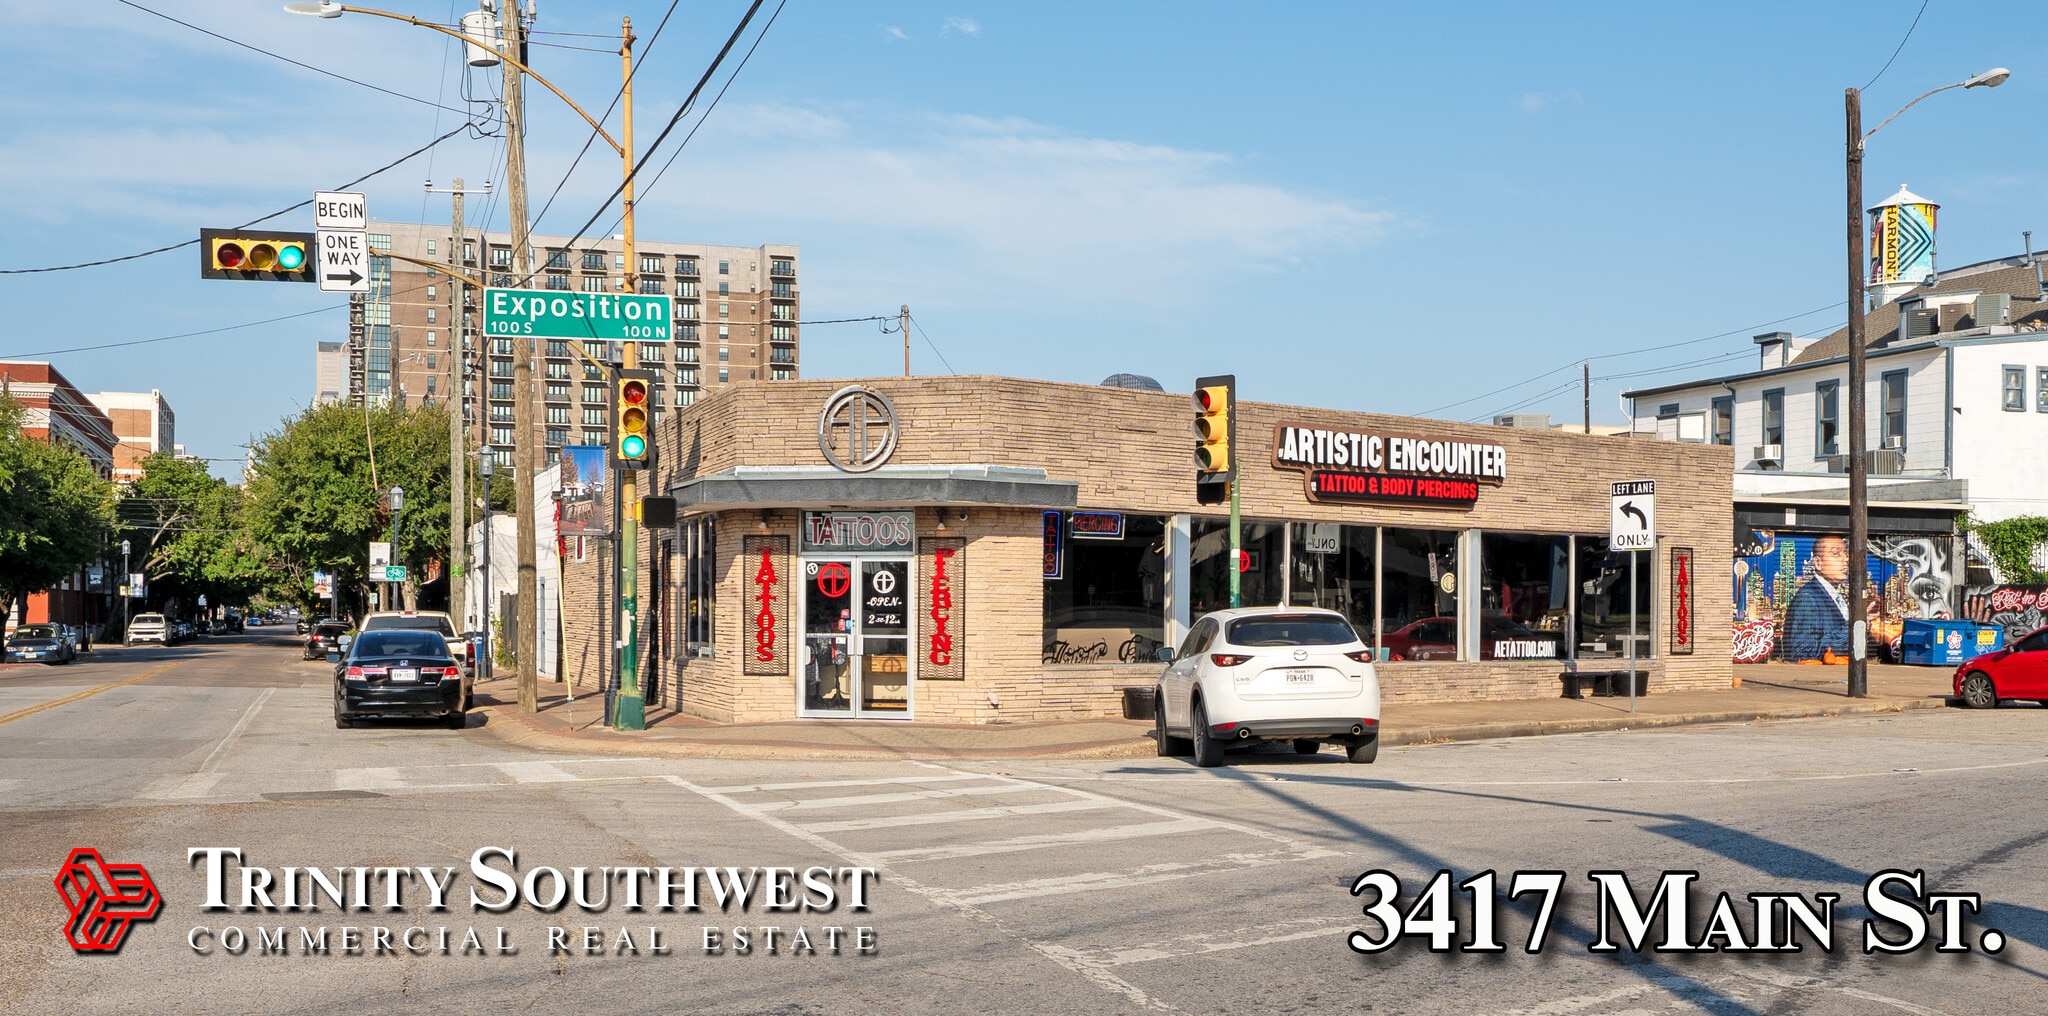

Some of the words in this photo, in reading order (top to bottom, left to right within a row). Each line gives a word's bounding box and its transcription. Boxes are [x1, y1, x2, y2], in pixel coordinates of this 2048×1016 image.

[318, 202, 364, 219] BEGIN
[326, 235, 359, 250] ONE
[327, 251, 361, 266] WAY
[493, 291, 663, 322] Exposition
[491, 321, 520, 334] 100
[523, 322, 533, 335] S
[622, 325, 652, 338] 100
[655, 326, 666, 338] N
[1282, 427, 1383, 469] ARTISTIC
[1389, 437, 1507, 479] ENCOUNTER
[1319, 474, 1366, 495] TATTOO
[1368, 476, 1379, 495] &
[1381, 478, 1414, 497] BODY
[1416, 480, 1477, 499] PIERCINGS
[1612, 484, 1630, 495] LEFT
[1633, 482, 1653, 494] LANE
[808, 515, 910, 546] TATTOOS
[1073, 513, 1118, 532] PIERCING
[1043, 514, 1058, 573] TATTOO
[1617, 534, 1649, 546] ONLY
[755, 546, 778, 663] TATTOOS
[929, 547, 955, 666] PIERCING
[1677, 556, 1689, 644] TATTOOS
[1493, 640, 1556, 658] AETATTOO.COM
